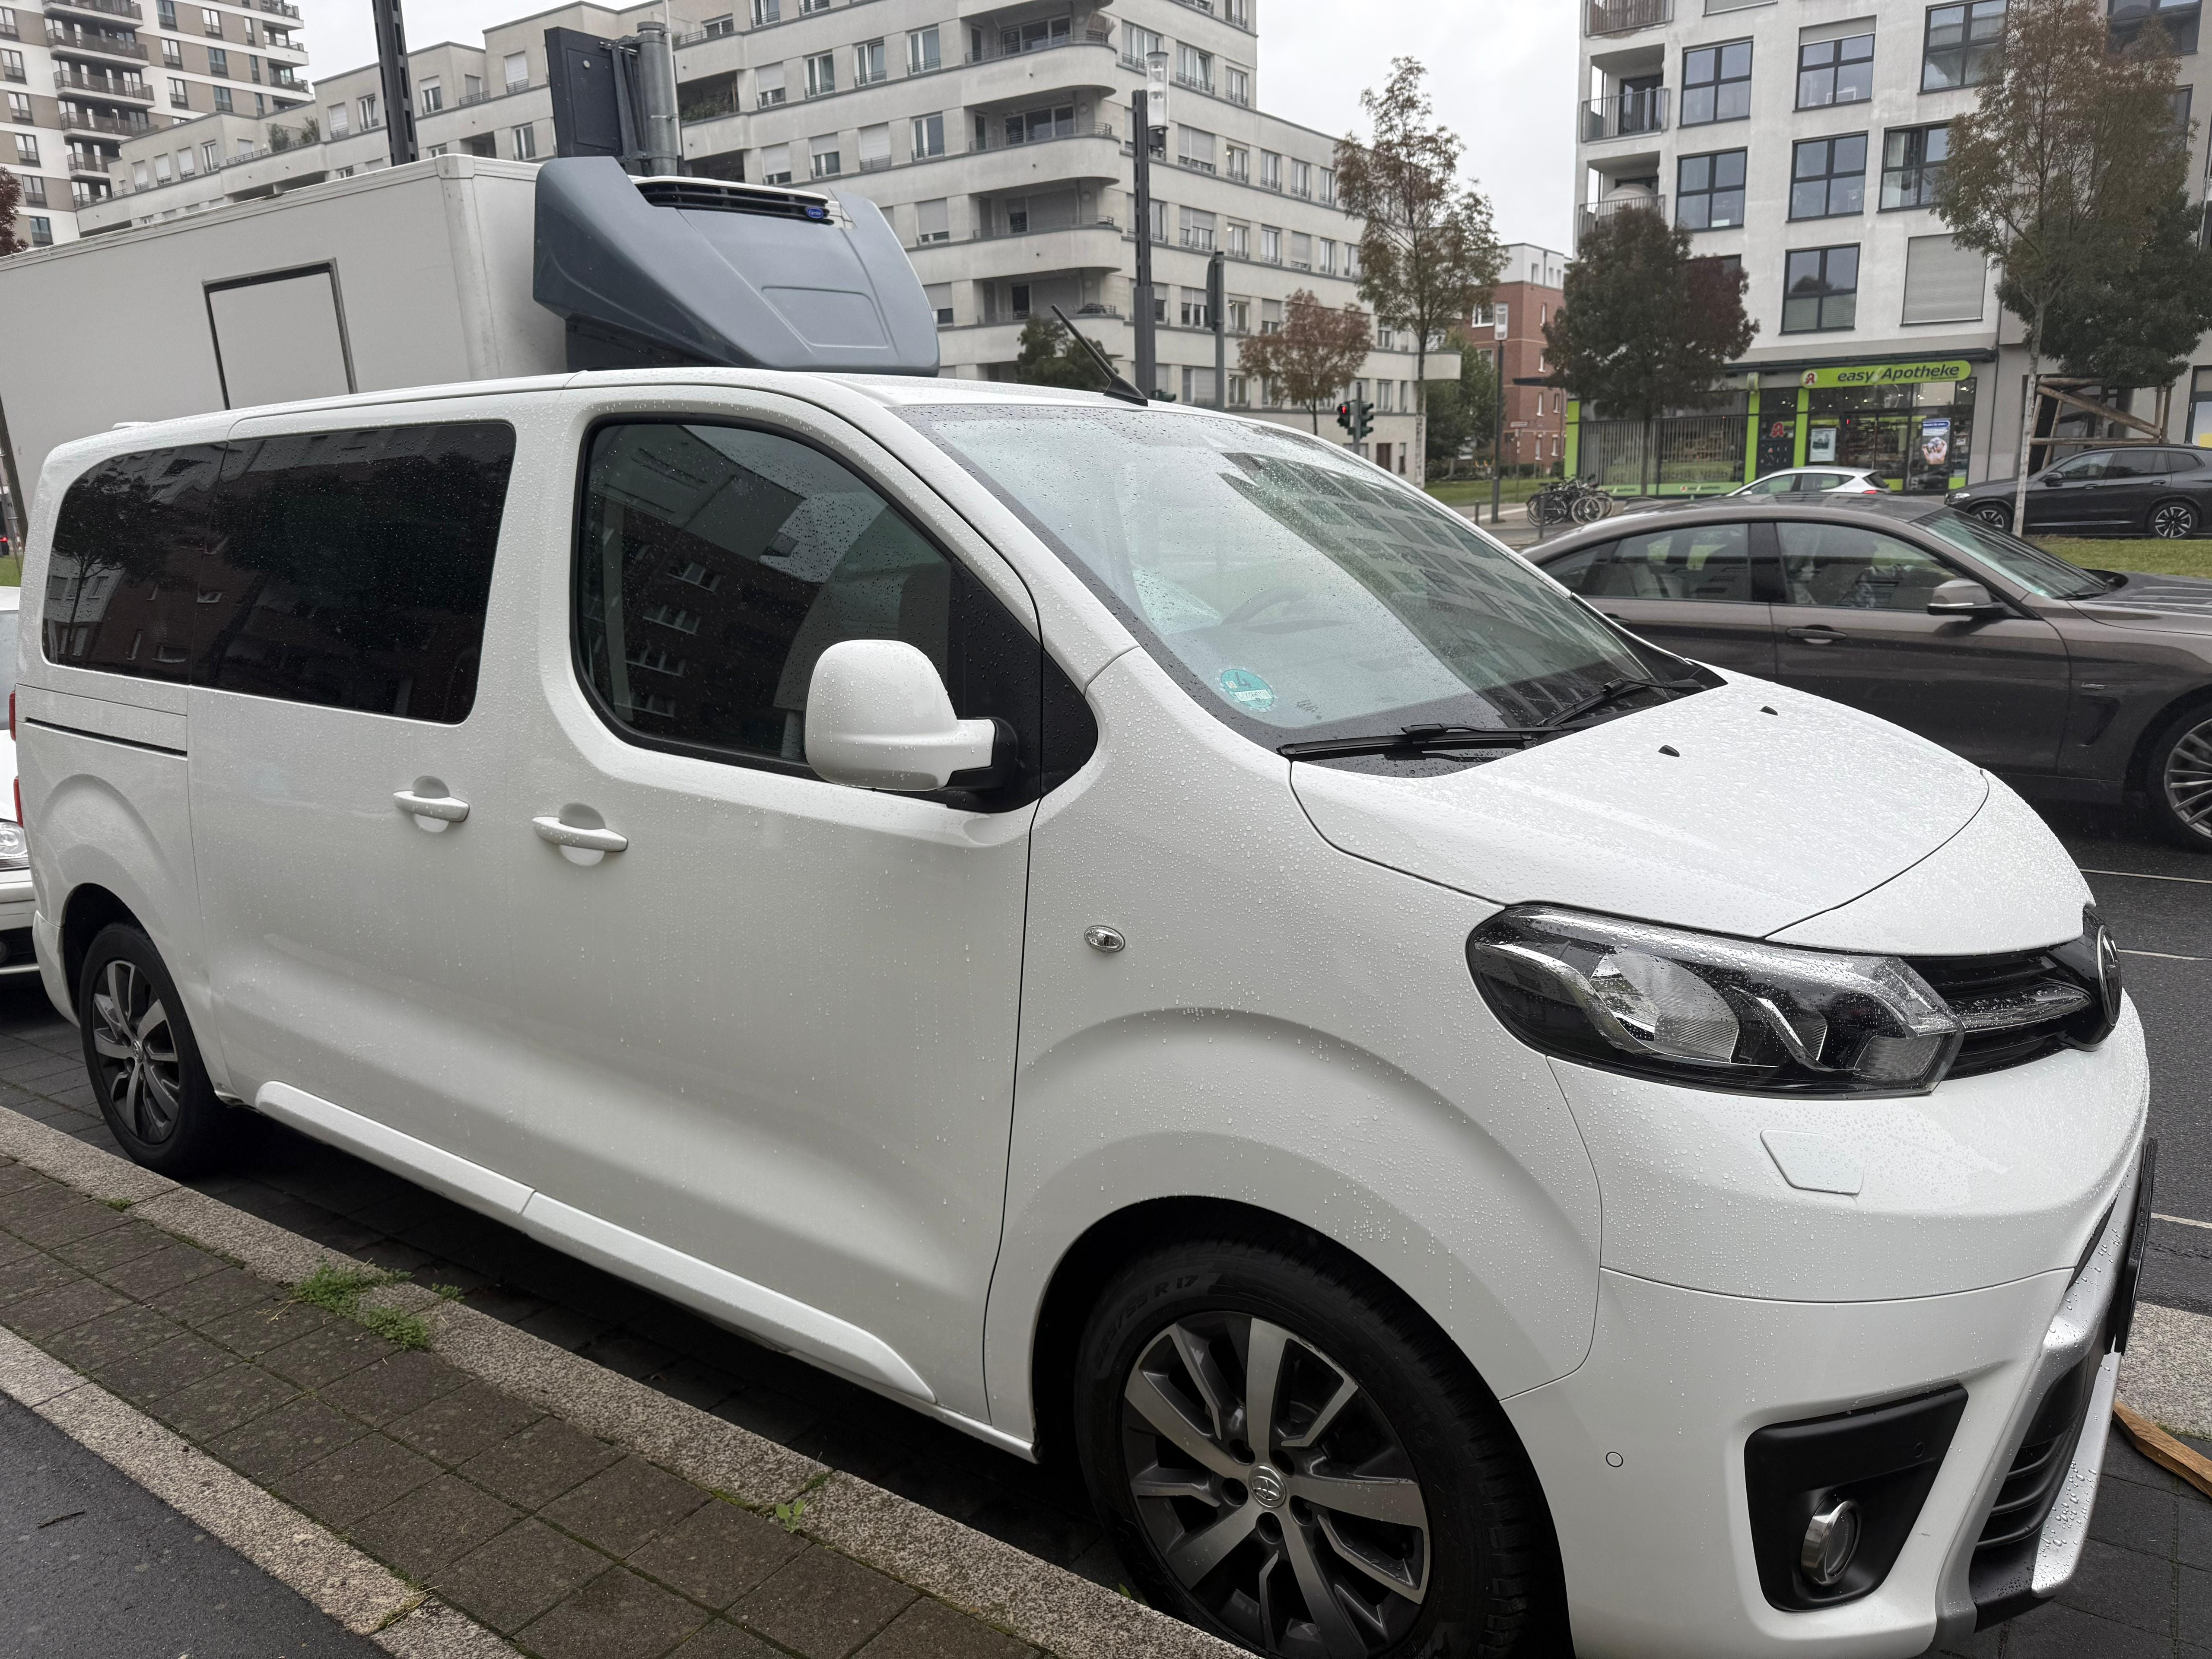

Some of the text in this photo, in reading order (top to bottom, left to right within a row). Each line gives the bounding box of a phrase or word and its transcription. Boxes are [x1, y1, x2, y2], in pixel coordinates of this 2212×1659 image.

[1805, 364, 1959, 385] A easy Apotheke
[1235, 672, 1252, 688] 4
[1154, 1275, 1199, 1297] R 17
